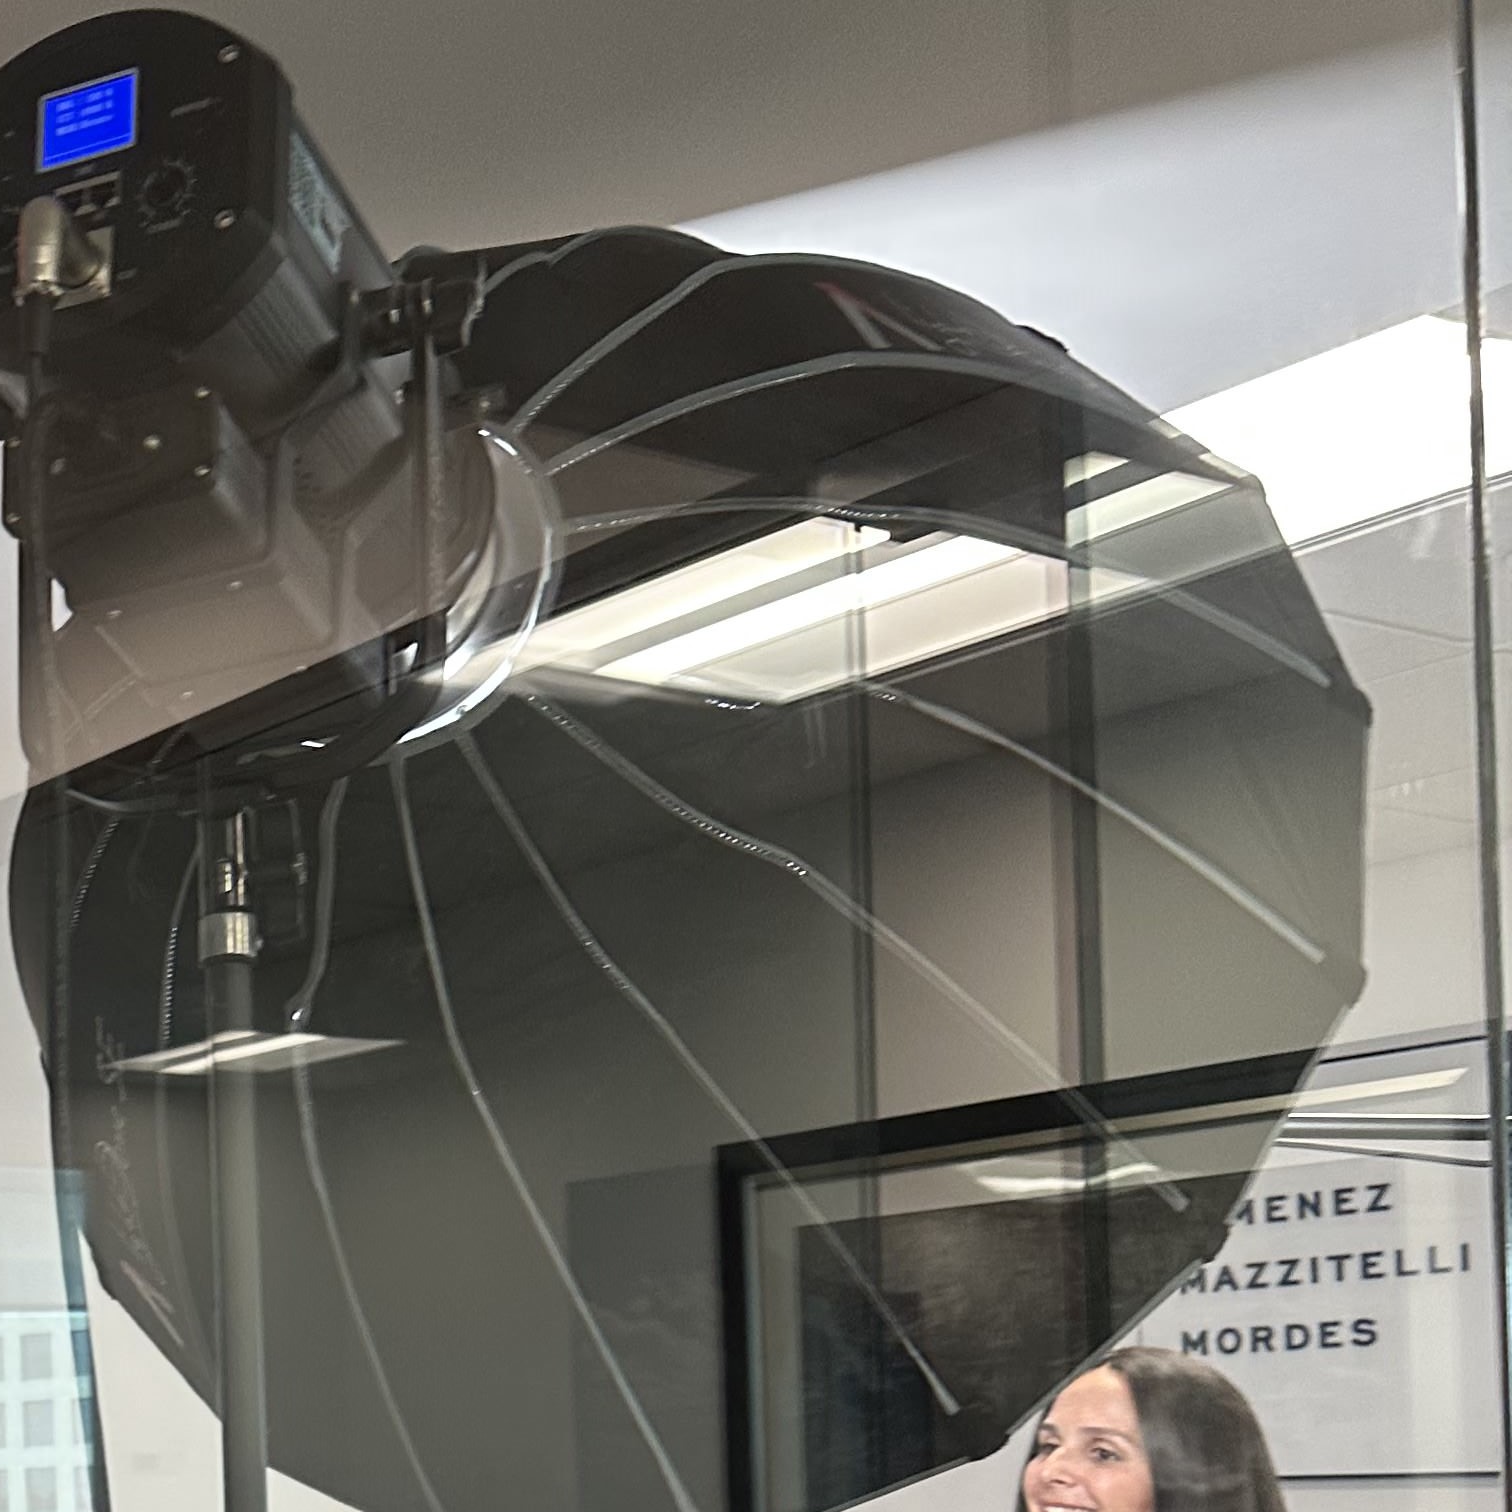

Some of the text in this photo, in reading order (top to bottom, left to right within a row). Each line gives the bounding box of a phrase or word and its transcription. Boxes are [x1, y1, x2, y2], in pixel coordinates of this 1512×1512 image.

[1235, 1183, 1393, 1225] MENEZ
[1179, 1243, 1472, 1295] MAZZITELLI
[1181, 1318, 1378, 1357] MORDES
